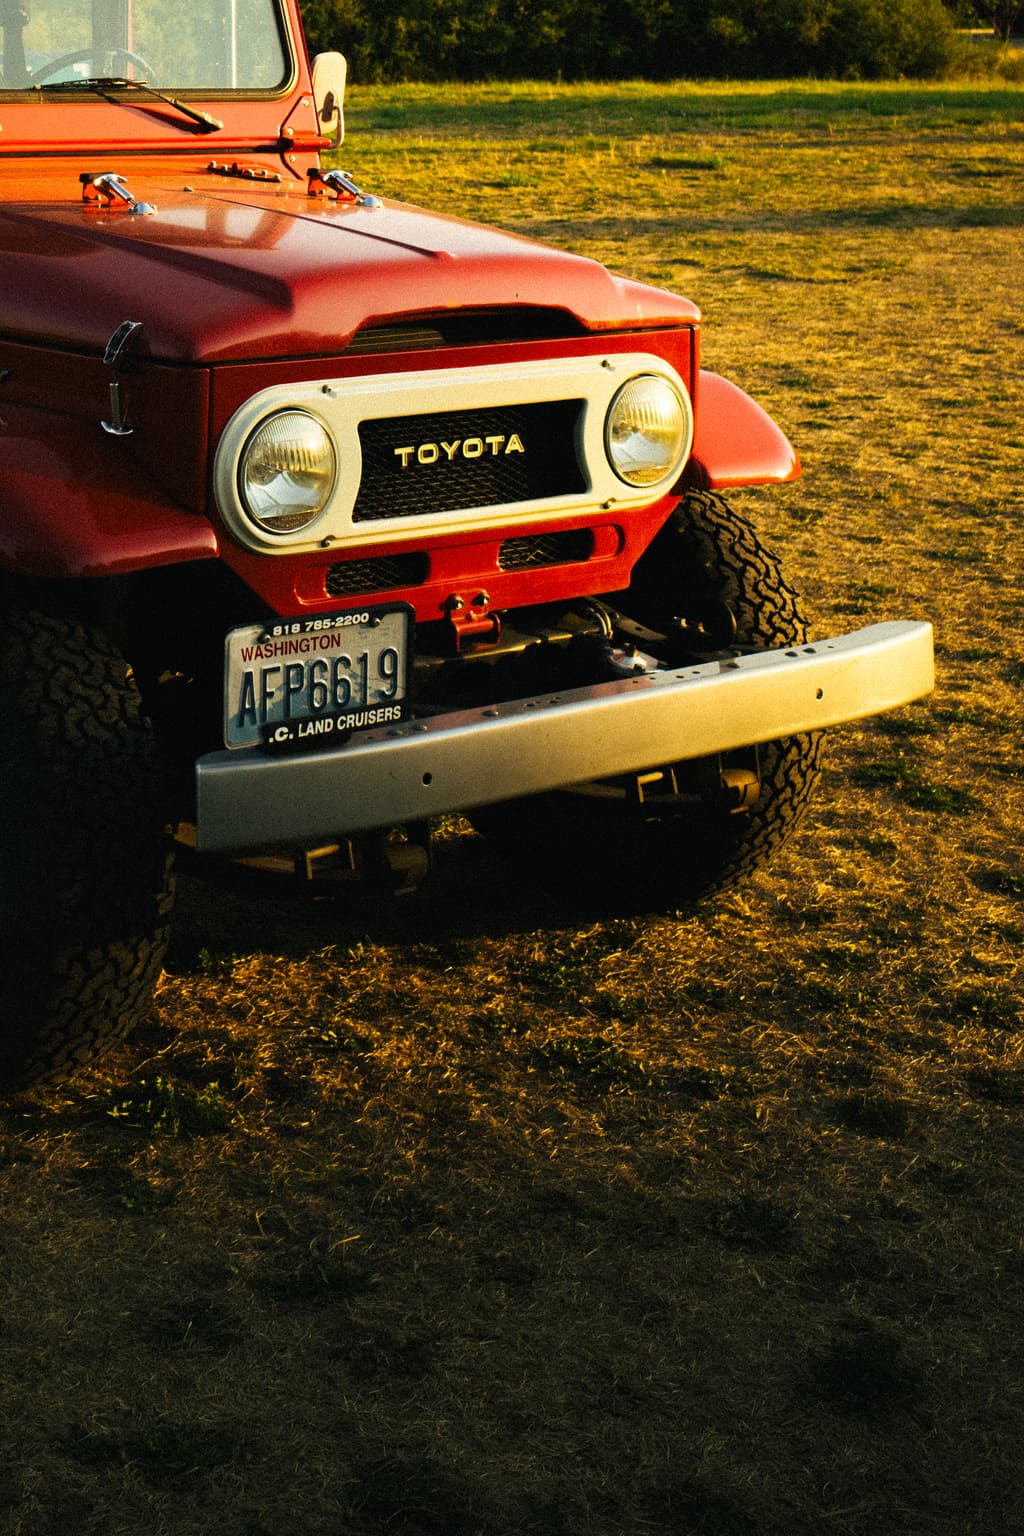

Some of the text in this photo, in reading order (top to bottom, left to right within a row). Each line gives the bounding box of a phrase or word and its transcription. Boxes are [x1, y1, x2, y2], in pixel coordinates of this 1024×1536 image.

[394, 434, 525, 467] TOYOTA
[273, 612, 370, 636] 818 785-2200
[241, 633, 341, 662] WASHINGTON
[236, 647, 398, 728] AFP6619
[298, 719, 333, 738] LAND
[337, 705, 402, 731] CRUISERS
